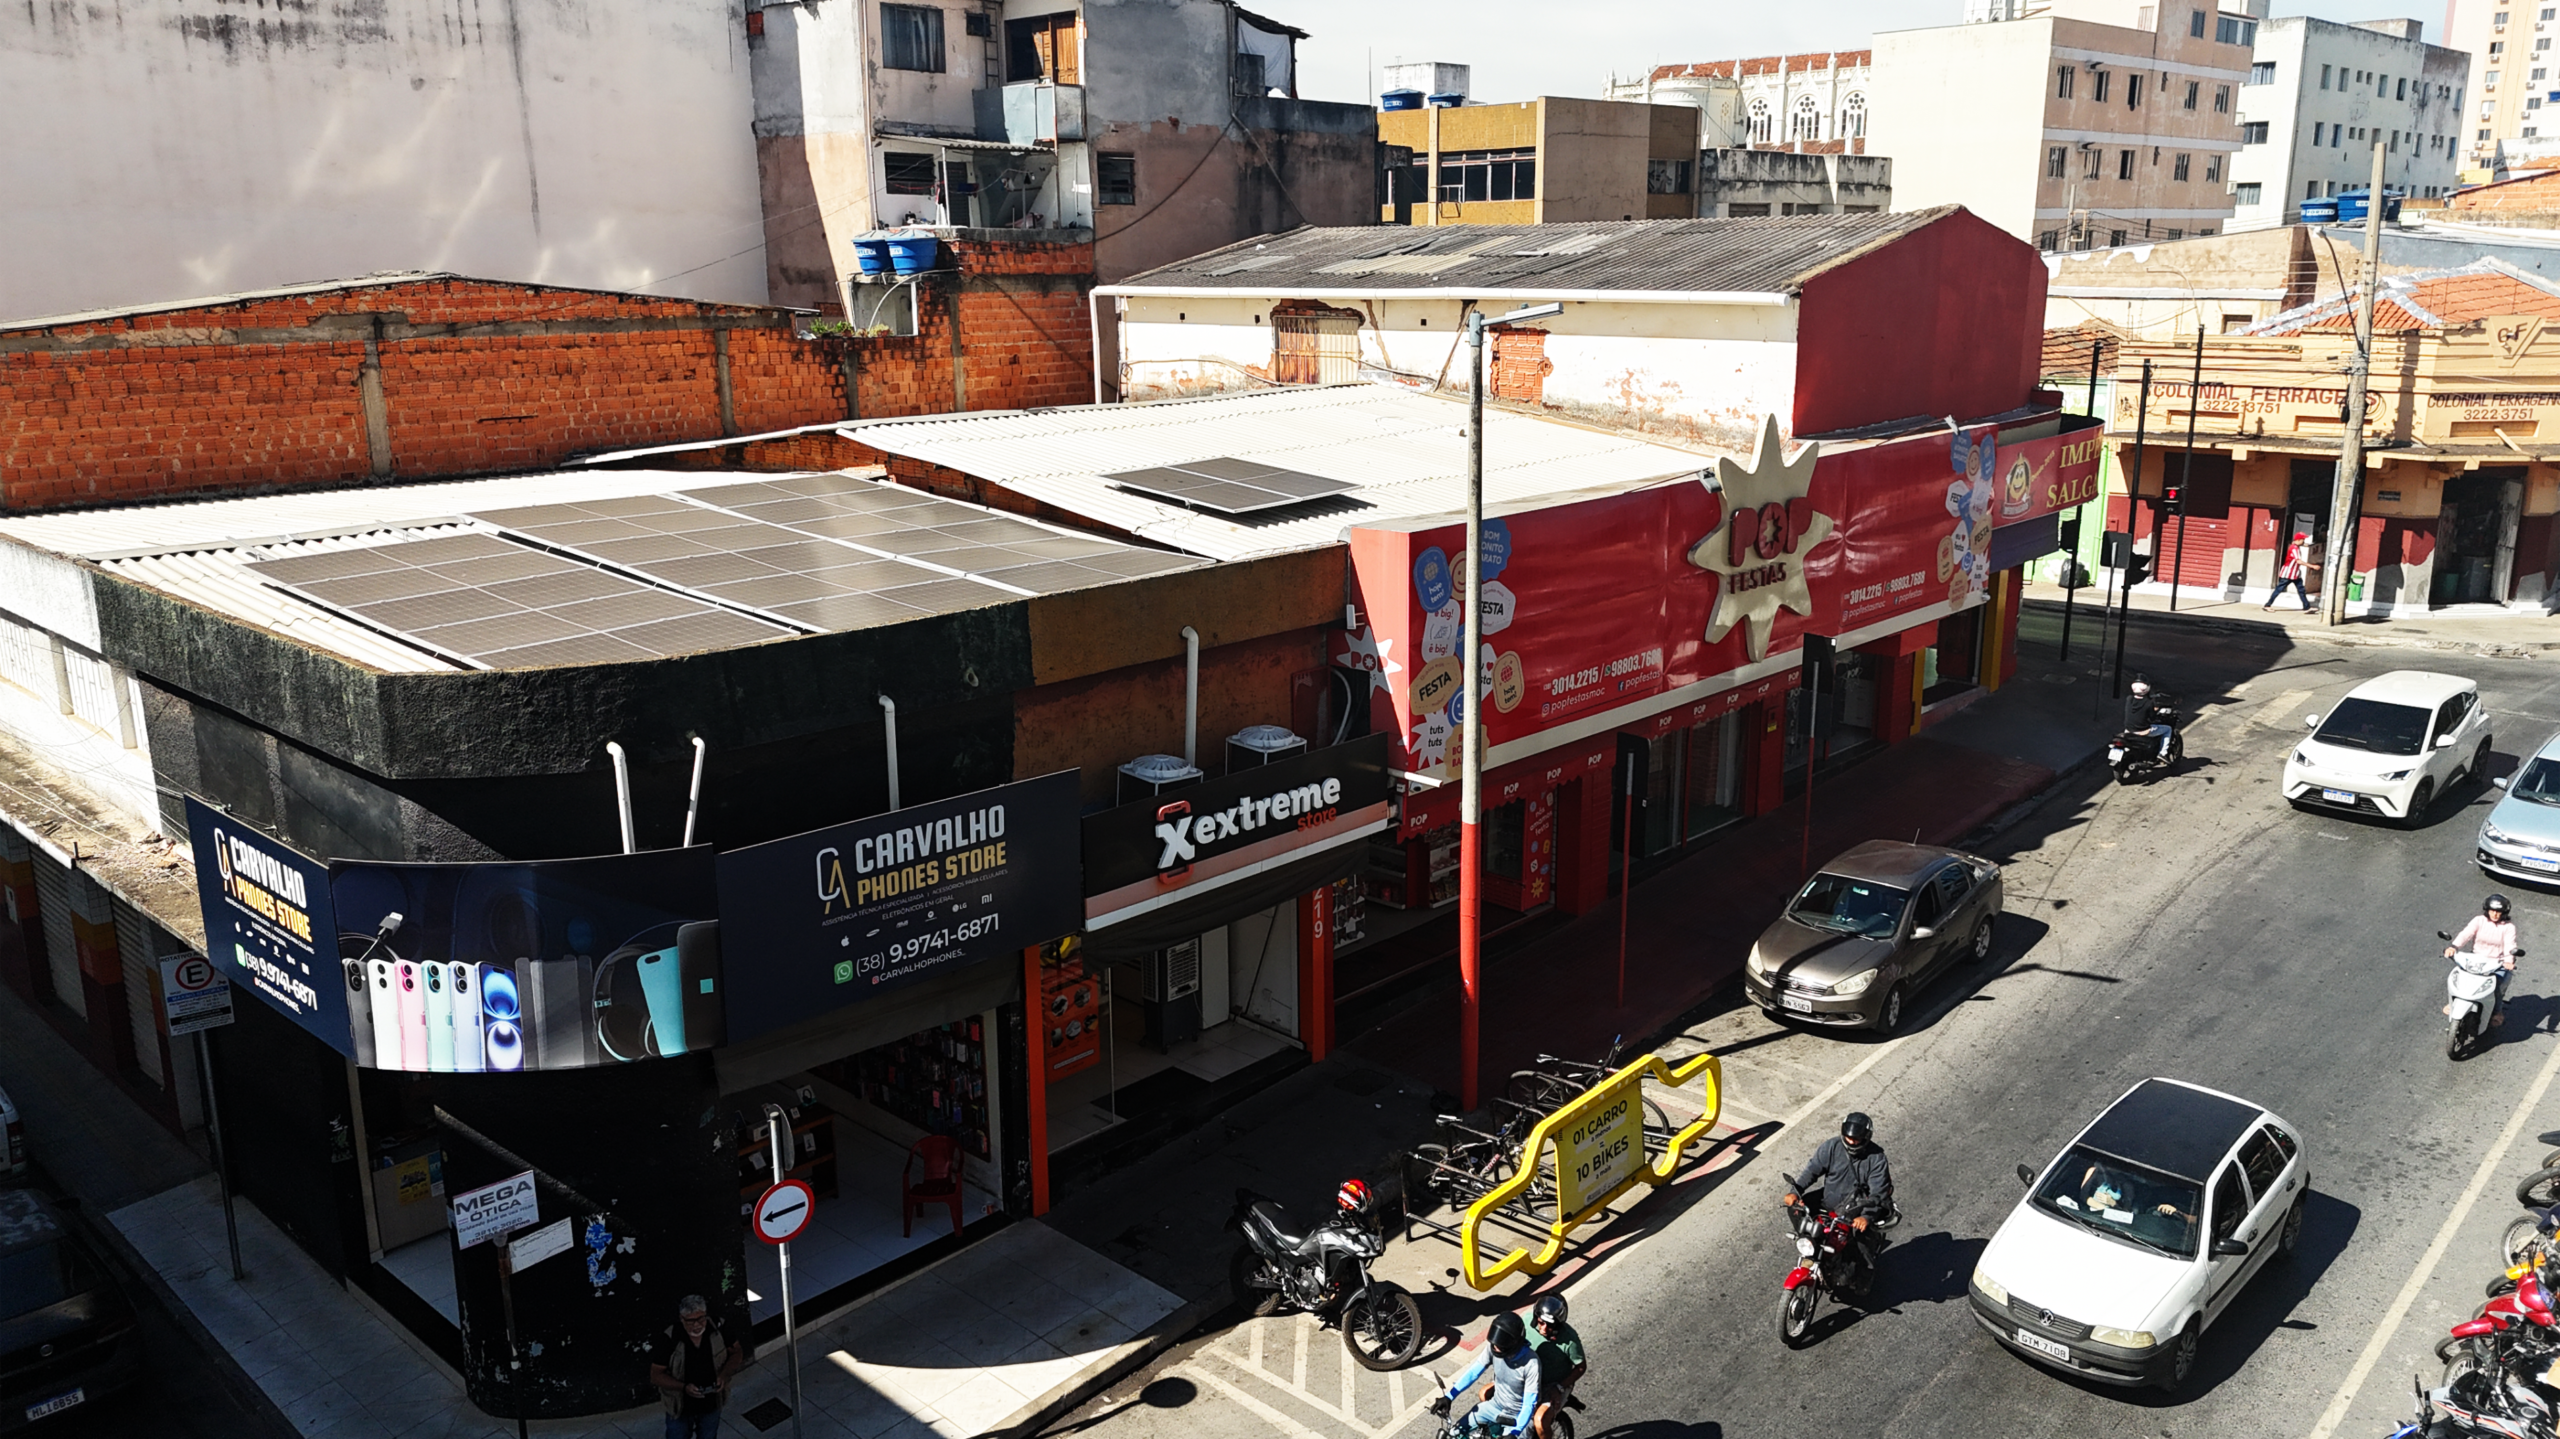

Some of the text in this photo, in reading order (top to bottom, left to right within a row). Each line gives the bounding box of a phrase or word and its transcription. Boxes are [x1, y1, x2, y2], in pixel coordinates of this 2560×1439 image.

[2152, 384, 2377, 407] COLONIAL FERRAGES
[2428, 394, 2487, 408] COLONIAL
[1484, 530, 1500, 541] BOM
[1728, 497, 1813, 567] POP
[1974, 526, 1989, 544] FESTA
[1481, 542, 1504, 553] ONITO
[1727, 562, 1787, 594] FESTAS
[1428, 582, 1442, 595] hoje
[1430, 589, 1445, 604] tem!
[1440, 608, 1454, 620] big!
[1480, 601, 1504, 615] ESTA
[1435, 645, 1448, 656] big!
[1351, 651, 1388, 673] POP
[1552, 666, 1599, 695] 3014.2215
[1787, 670, 1800, 682] POP
[1418, 671, 1452, 702] FESTA
[1503, 684, 1516, 696] hoje
[1551, 669, 1661, 714] popfestasmoc popfestas
[1758, 683, 1770, 694] POP
[1504, 691, 1517, 704] tem!
[1727, 693, 1739, 704] POP
[1693, 704, 1706, 715] POP
[1659, 715, 1672, 727] POP
[1429, 725, 1444, 735] tuts
[1428, 737, 1443, 748] tuts
[1588, 753, 1602, 766] POP
[1547, 767, 1562, 780] POP
[1504, 782, 1519, 795] POP
[1297, 807, 1337, 832] store
[1410, 813, 1427, 828] POP
[855, 804, 1005, 874] CARVALHO
[230, 835, 307, 909] CARVALHO
[857, 841, 1007, 905] PHONES STORE
[235, 875, 277, 921] PHONES
[276, 899, 313, 943] STORE
[856, 913, 999, 977] (38) 9.9741-6871
[245, 950, 260, 976] (38)
[186, 964, 204, 984] E
[1573, 1100, 1628, 1145] 01 CARRO
[1576, 1135, 1629, 1182] 10 BIKES
[1600, 1164, 1612, 1177] mais
[456, 1181, 532, 1215] MEGA
[470, 1199, 522, 1222] ÓTICA
